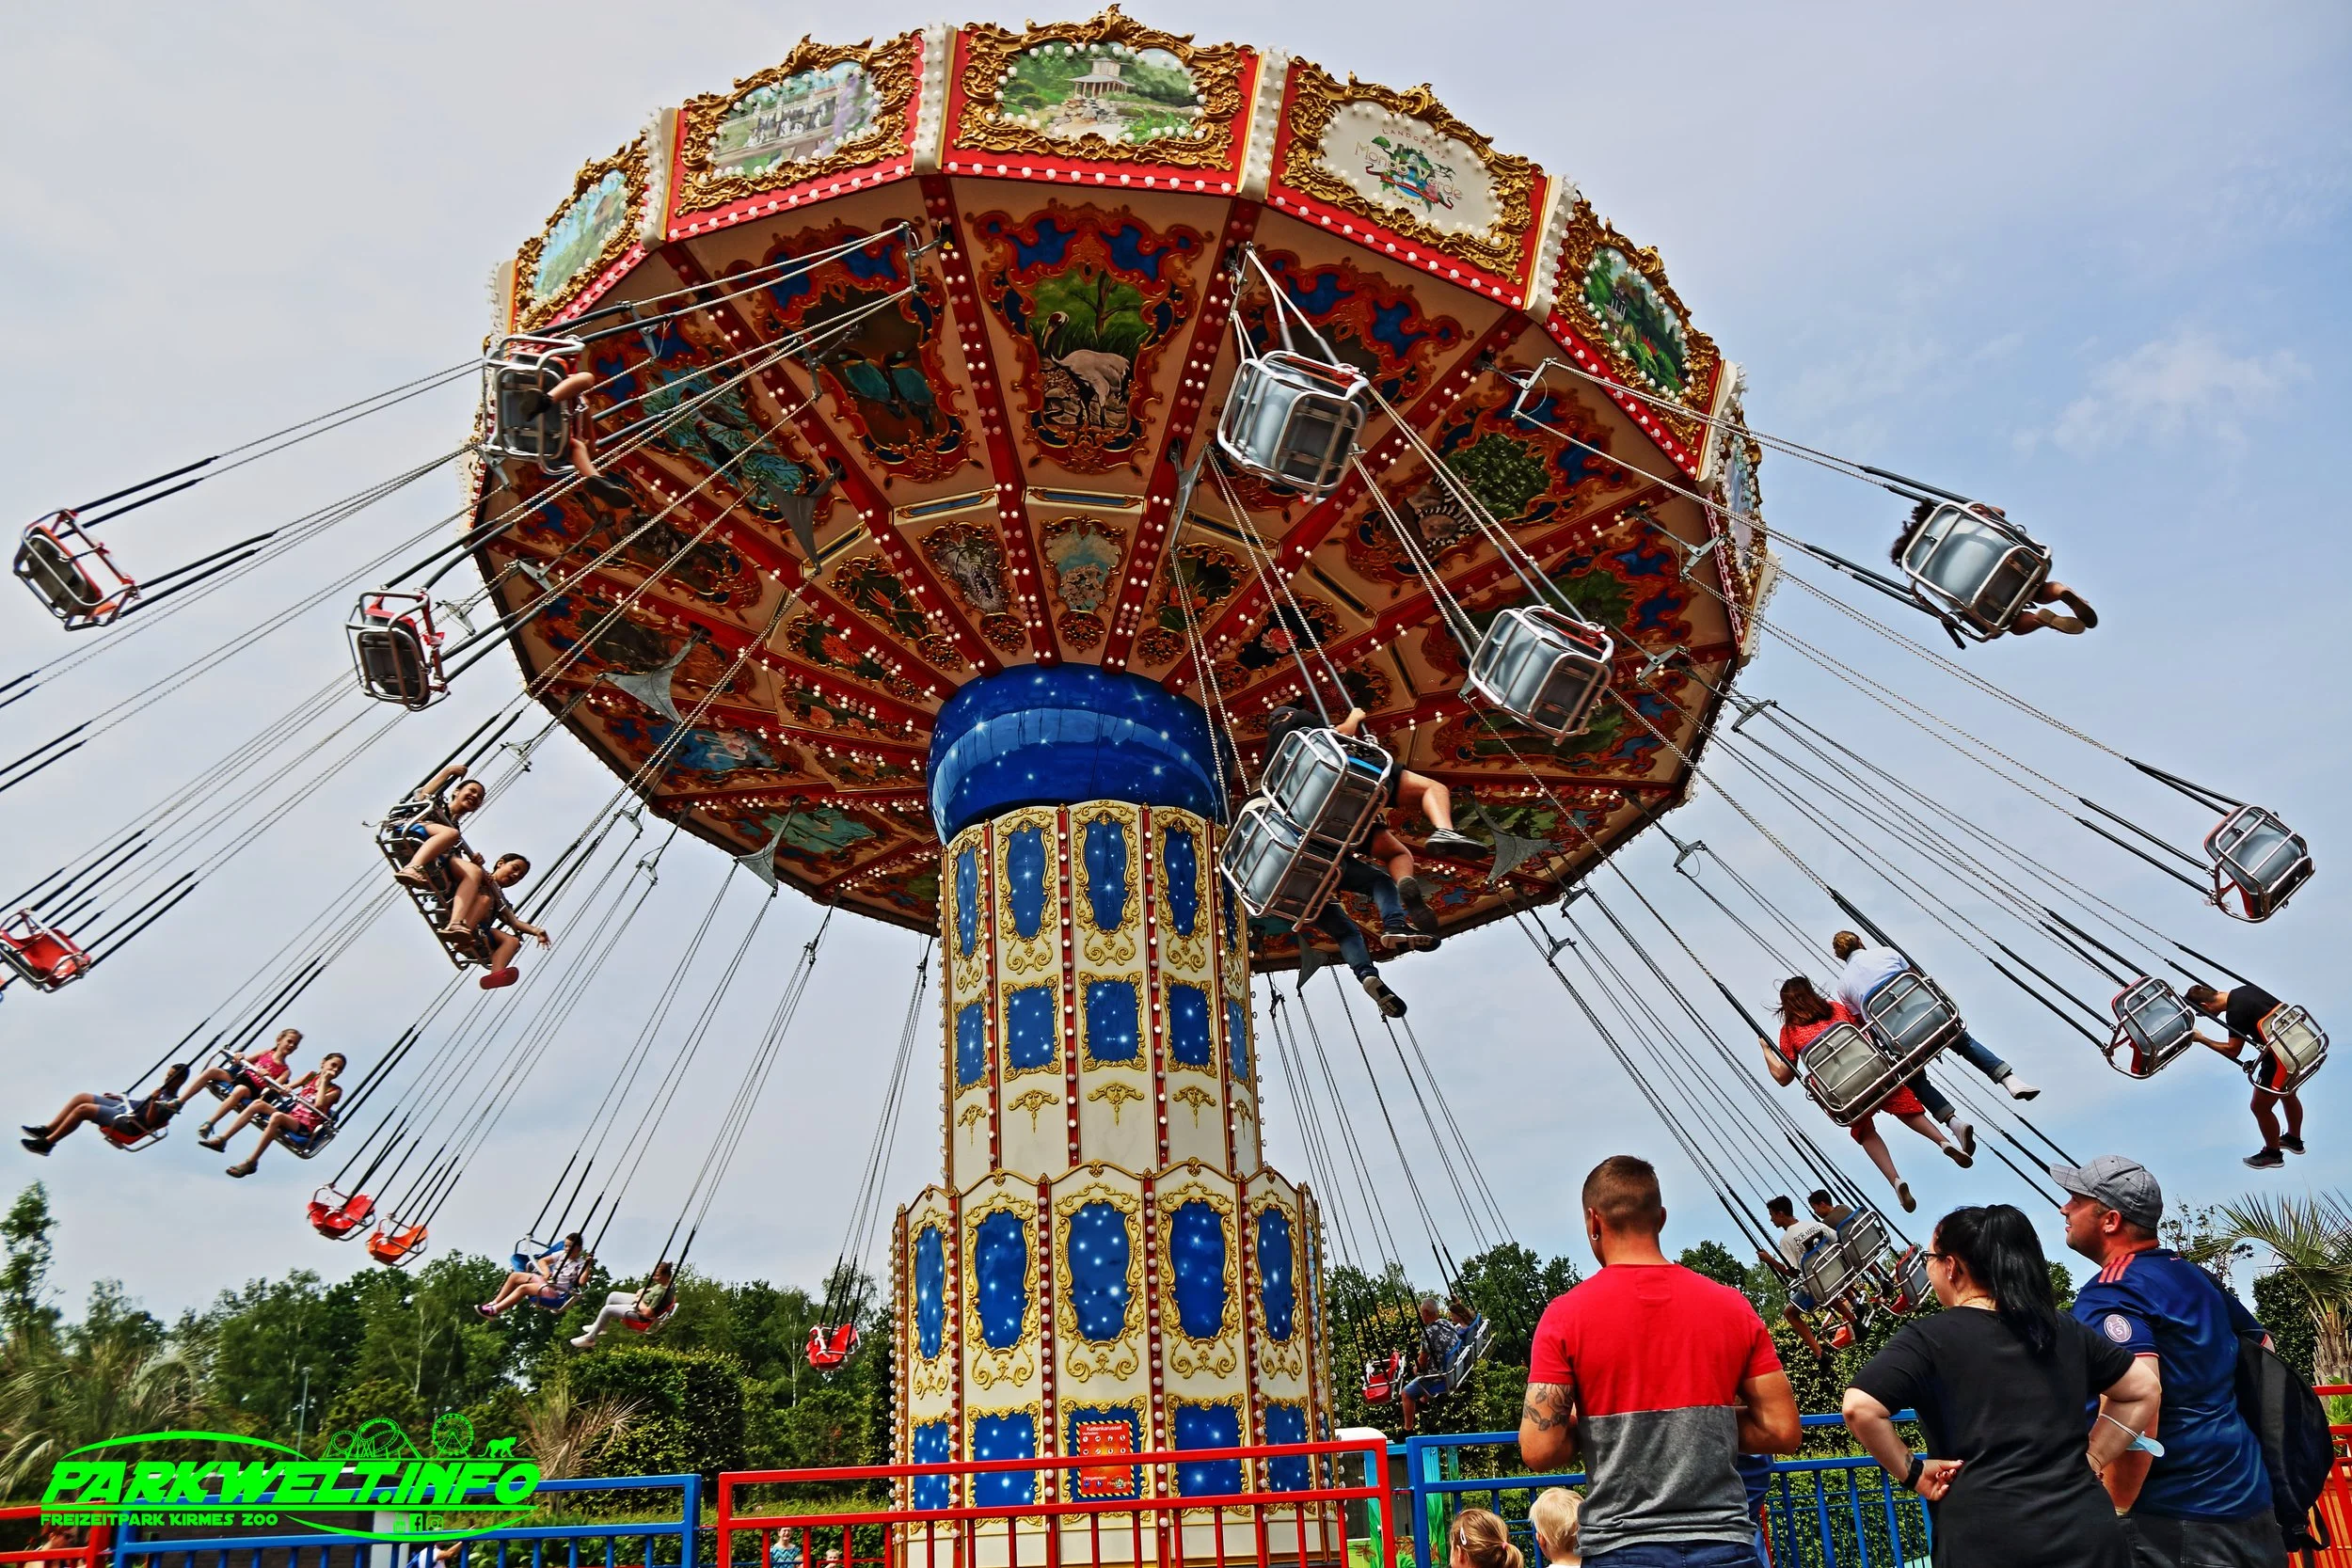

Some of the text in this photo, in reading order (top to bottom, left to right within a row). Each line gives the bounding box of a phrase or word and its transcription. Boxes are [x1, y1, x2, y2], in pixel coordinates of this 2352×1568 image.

[1382, 129, 1446, 159] LANDGRAAF
[1355, 141, 1409, 176] Mondo
[1418, 166, 1463, 200] Verde
[1793, 1232, 1806, 1244] BOB
[2116, 1326, 2122, 1336] 5
